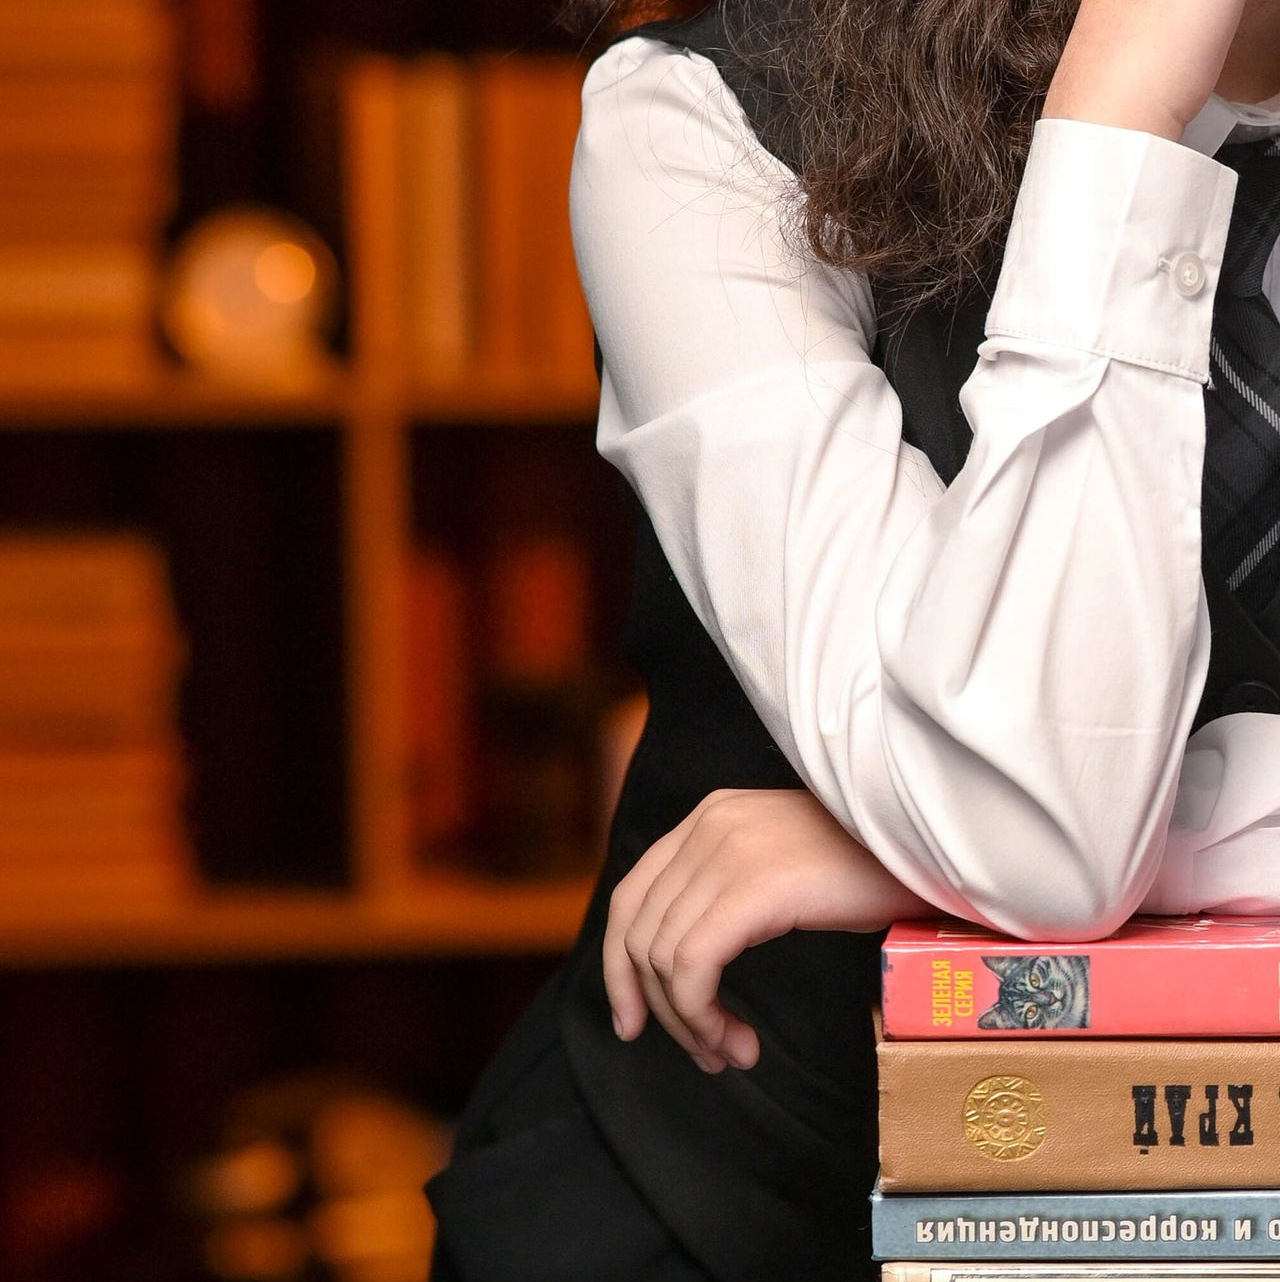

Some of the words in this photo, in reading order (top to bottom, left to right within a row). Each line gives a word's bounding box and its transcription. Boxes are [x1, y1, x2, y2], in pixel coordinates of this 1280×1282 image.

[932, 959, 952, 1026] ЗЕЛЕНАЯ
[954, 969, 974, 1017] СЕРИЯ
[1131, 1084, 1254, 1155] КРАЙ
[915, 1214, 1218, 1243] корреспонденция
[1234, 1218, 1252, 1241] и
